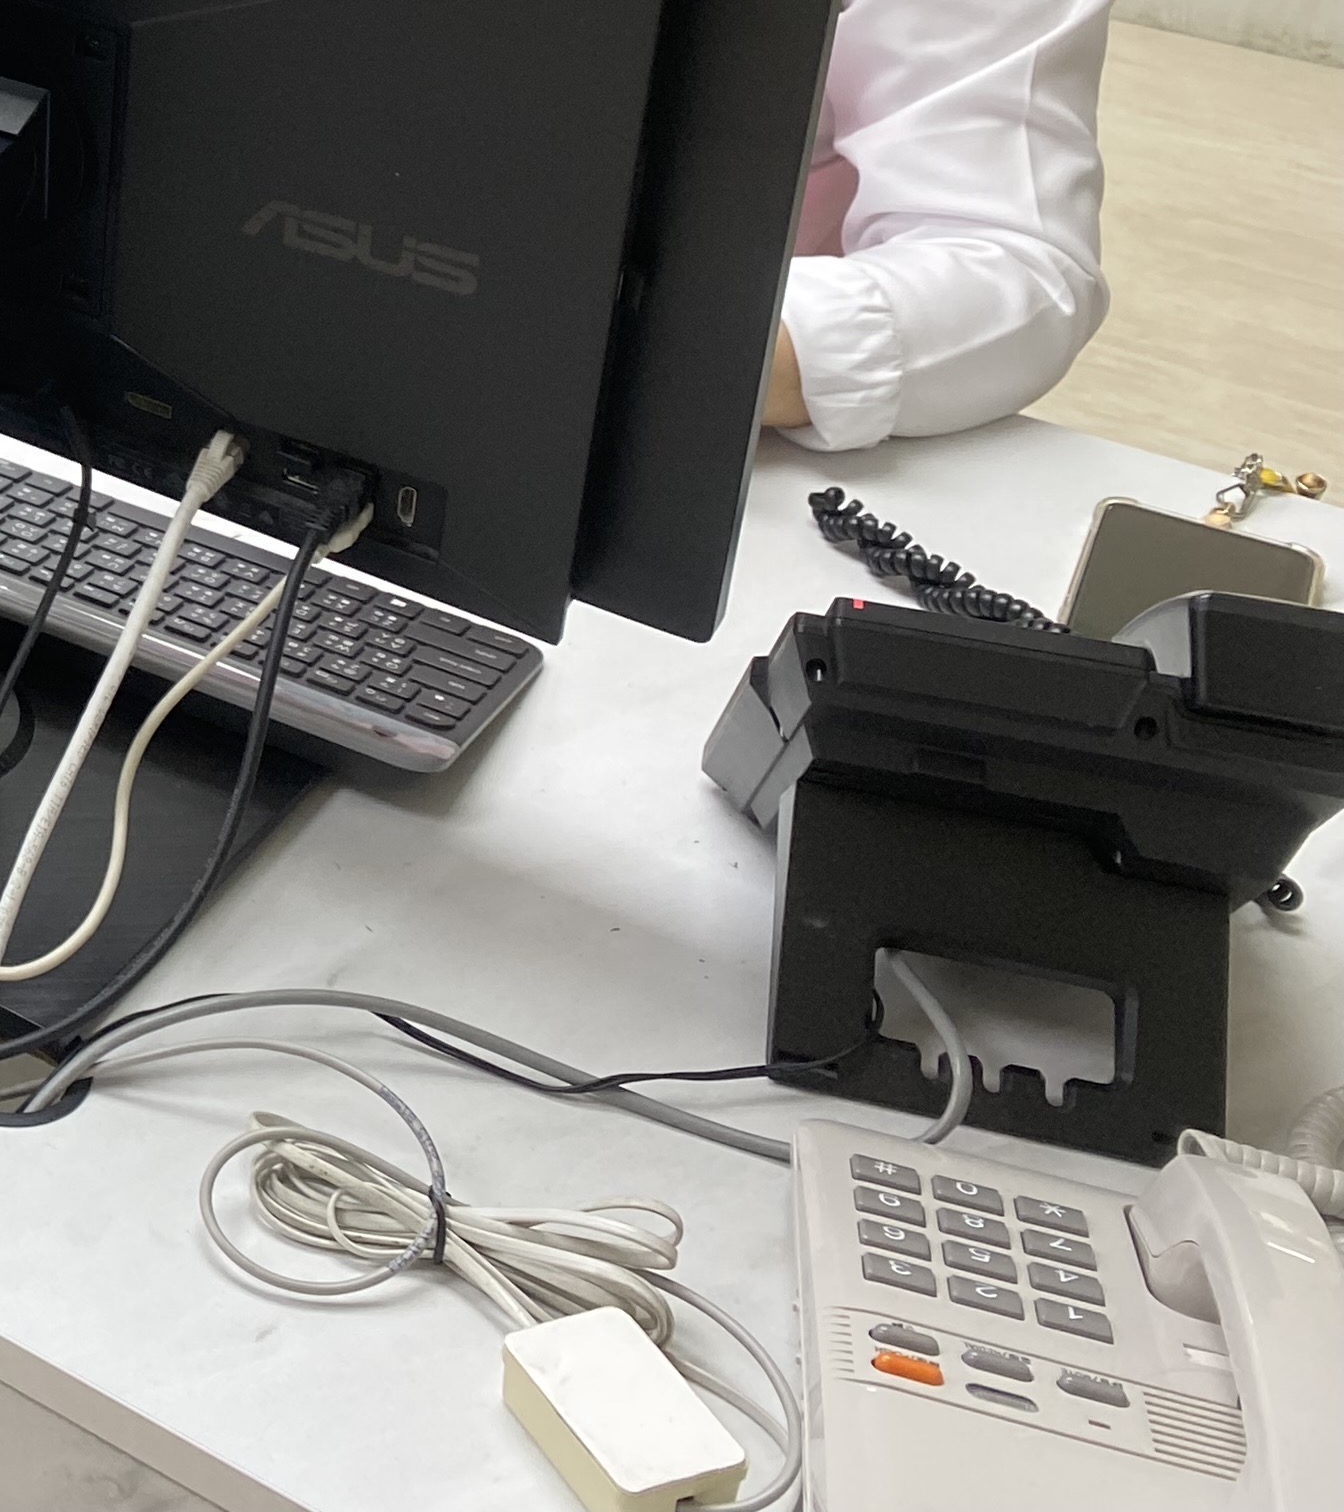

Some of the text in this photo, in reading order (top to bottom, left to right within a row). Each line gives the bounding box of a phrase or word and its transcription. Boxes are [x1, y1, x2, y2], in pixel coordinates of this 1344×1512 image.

[241, 200, 481, 296] ASUS
[957, 1180, 979, 1195] 0
[879, 1191, 901, 1206] 9
[963, 1213, 985, 1229] 8
[883, 1224, 906, 1240] 6
[1049, 1237, 1073, 1251] 7
[968, 1246, 992, 1263] 5
[889, 1259, 913, 1276] 3
[1054, 1268, 1079, 1283] 4
[976, 1285, 998, 1298] 2
[1067, 1306, 1084, 1320] 1
